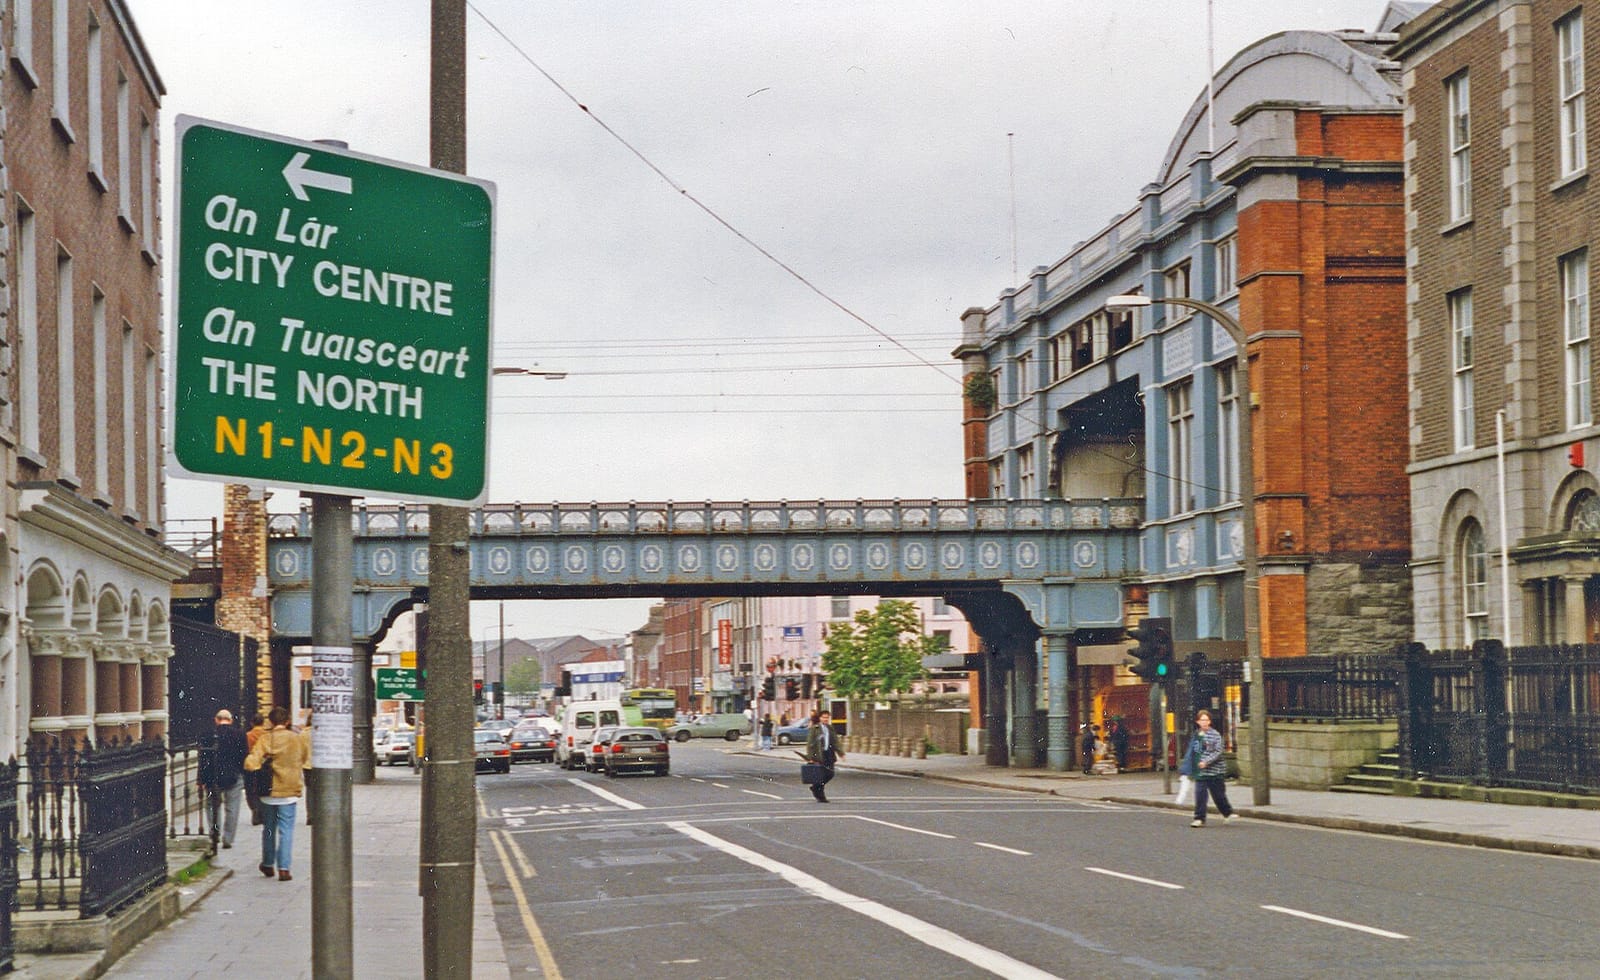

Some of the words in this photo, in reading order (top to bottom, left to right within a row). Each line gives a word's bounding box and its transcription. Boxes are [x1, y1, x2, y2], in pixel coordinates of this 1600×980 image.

[275, 207, 338, 250] Lár
[205, 242, 294, 288] CITY
[313, 260, 453, 317] CENTRE
[202, 356, 277, 401] THE
[297, 370, 423, 420] NORTH
